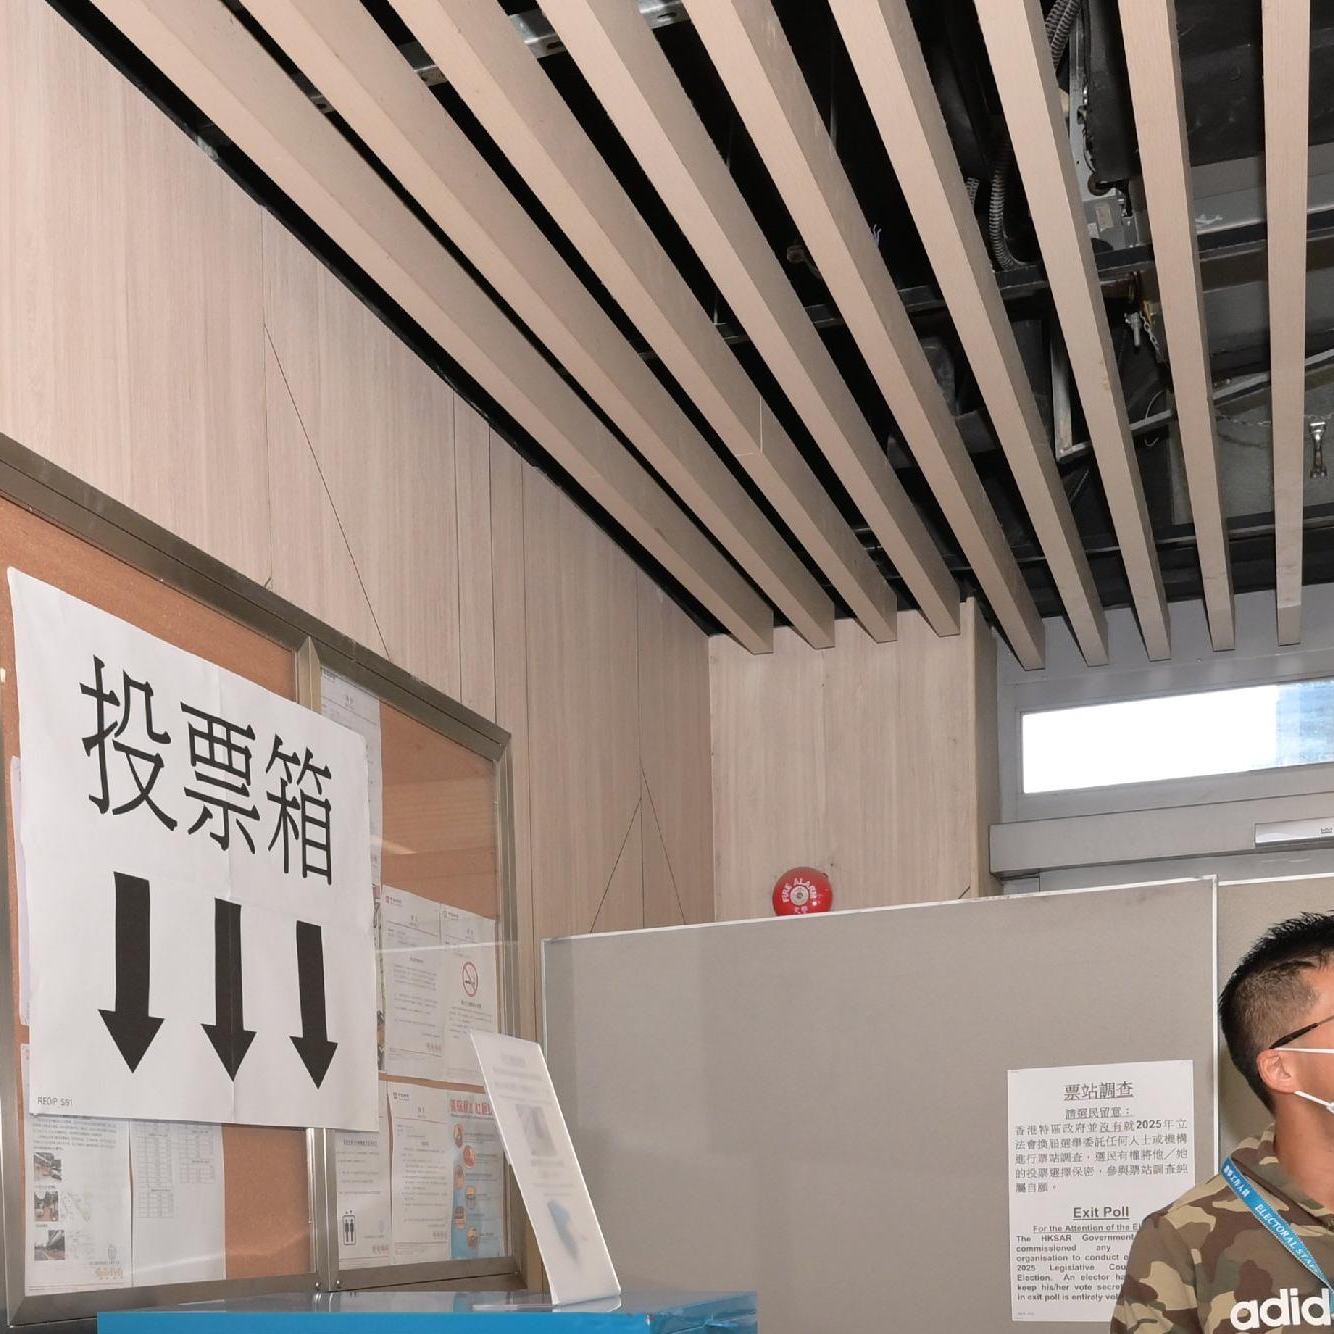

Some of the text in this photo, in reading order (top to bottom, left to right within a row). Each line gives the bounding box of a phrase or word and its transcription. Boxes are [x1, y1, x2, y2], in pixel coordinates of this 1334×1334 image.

[79, 655, 334, 887] 投票箱
[1064, 1081, 1134, 1100] 票站調查
[1073, 1206, 1130, 1219] Exit Poll
[1065, 1224, 1104, 1233] Attention
[1255, 1203, 1298, 1250] ELECTORAL
[1082, 1234, 1134, 1242] Government
[1016, 1255, 1068, 1263] organisation
[1049, 1264, 1095, 1273] Legislative
[1017, 1284, 1037, 1292] keep
[1044, 1293, 1060, 1302] poll
[1071, 1293, 1103, 1302] entirely
